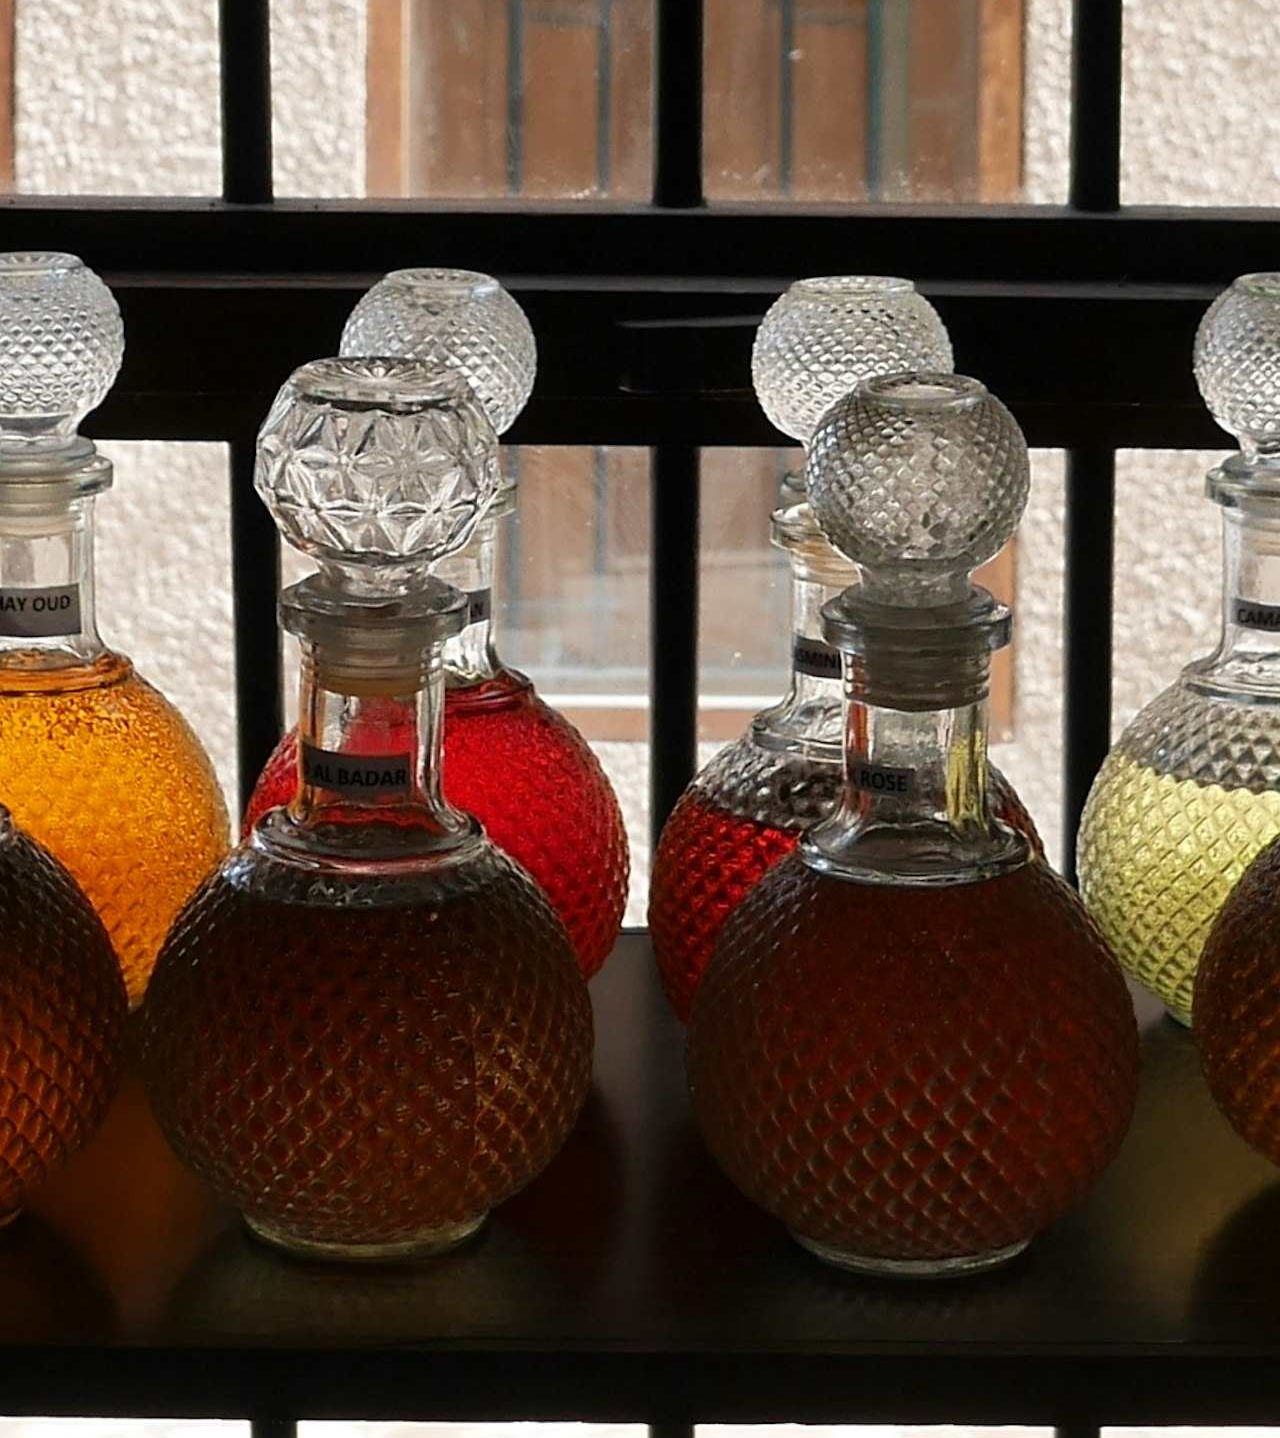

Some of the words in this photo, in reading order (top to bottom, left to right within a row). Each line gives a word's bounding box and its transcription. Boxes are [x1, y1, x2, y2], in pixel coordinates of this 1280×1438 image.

[32, 594, 72, 612] OUD
[312, 764, 333, 783] AL
[337, 767, 408, 787] BADAR
[860, 769, 908, 792] ROSE
